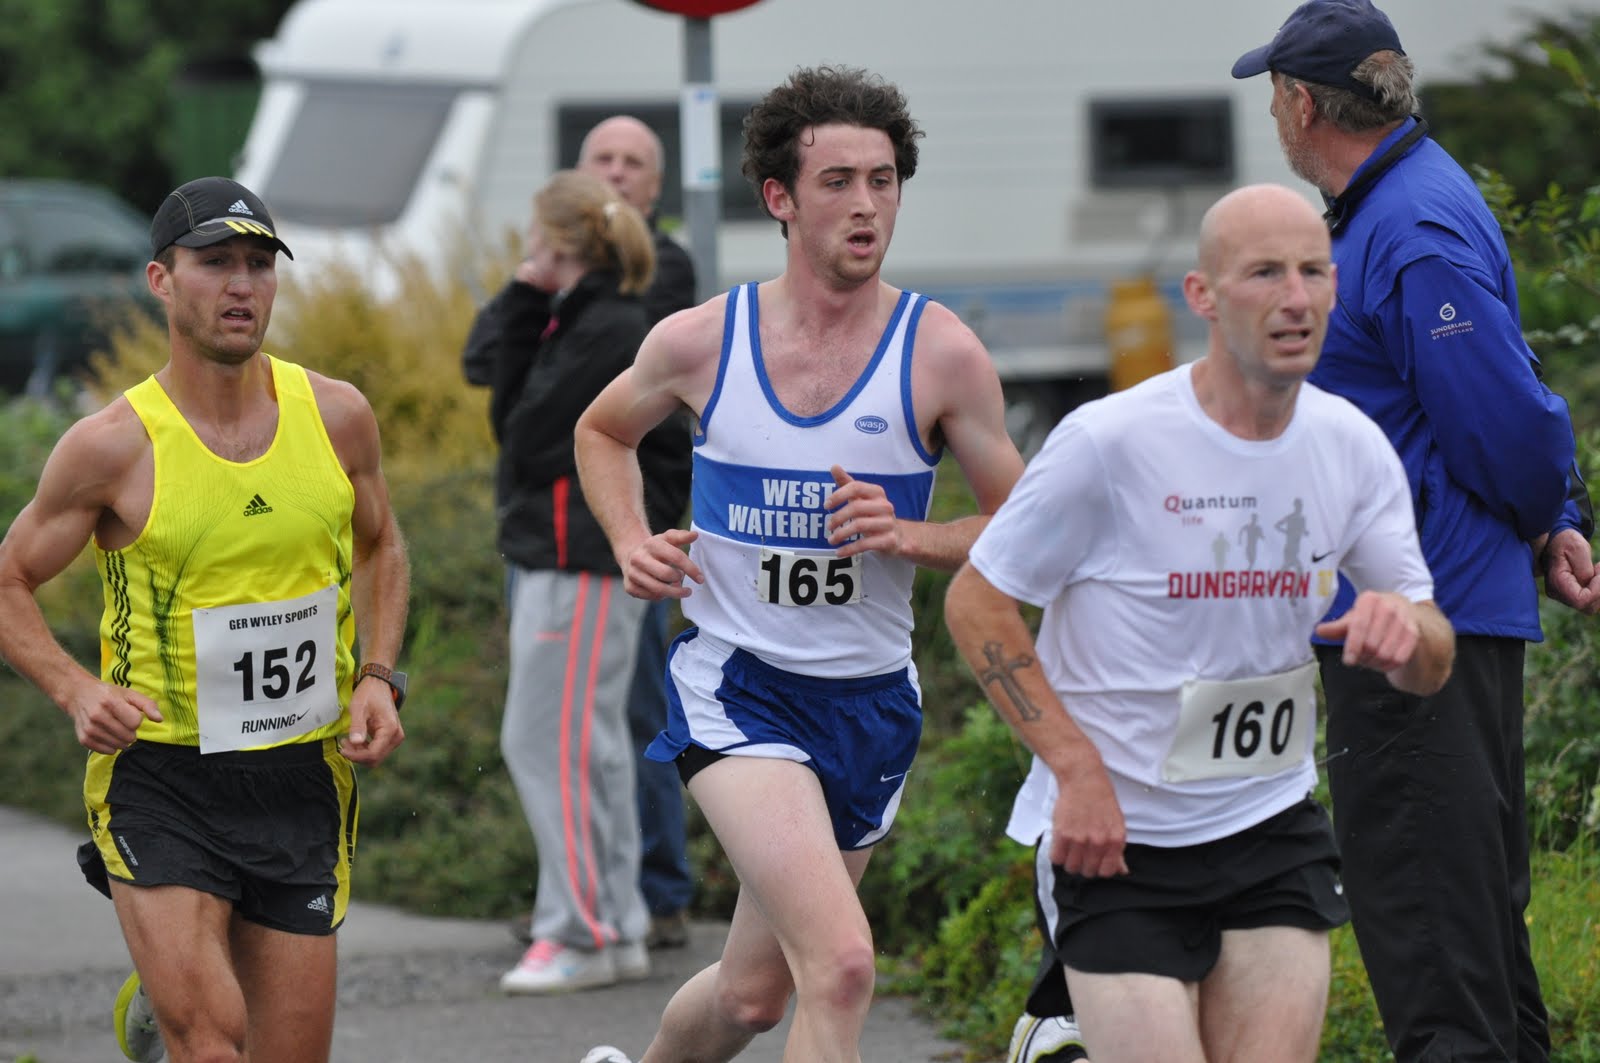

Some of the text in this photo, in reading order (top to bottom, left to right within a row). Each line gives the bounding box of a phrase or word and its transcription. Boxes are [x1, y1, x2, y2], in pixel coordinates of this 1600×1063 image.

[1430, 320, 1473, 335] SUNDERLAND
[1442, 327, 1474, 337] SCOTLAND
[860, 420, 885, 432] wasp
[762, 478, 837, 509] WEST
[1164, 495, 1257, 514] Quantum
[243, 506, 273, 517] adidas
[728, 504, 865, 541] WATERF
[761, 554, 854, 606] 165
[1168, 570, 1311, 599] DUNGARVAN
[229, 605, 318, 631] GER WYLEY SPORTS
[233, 639, 317, 702] 152
[241, 713, 296, 734] RUNNING
[1212, 698, 1295, 759] 160
